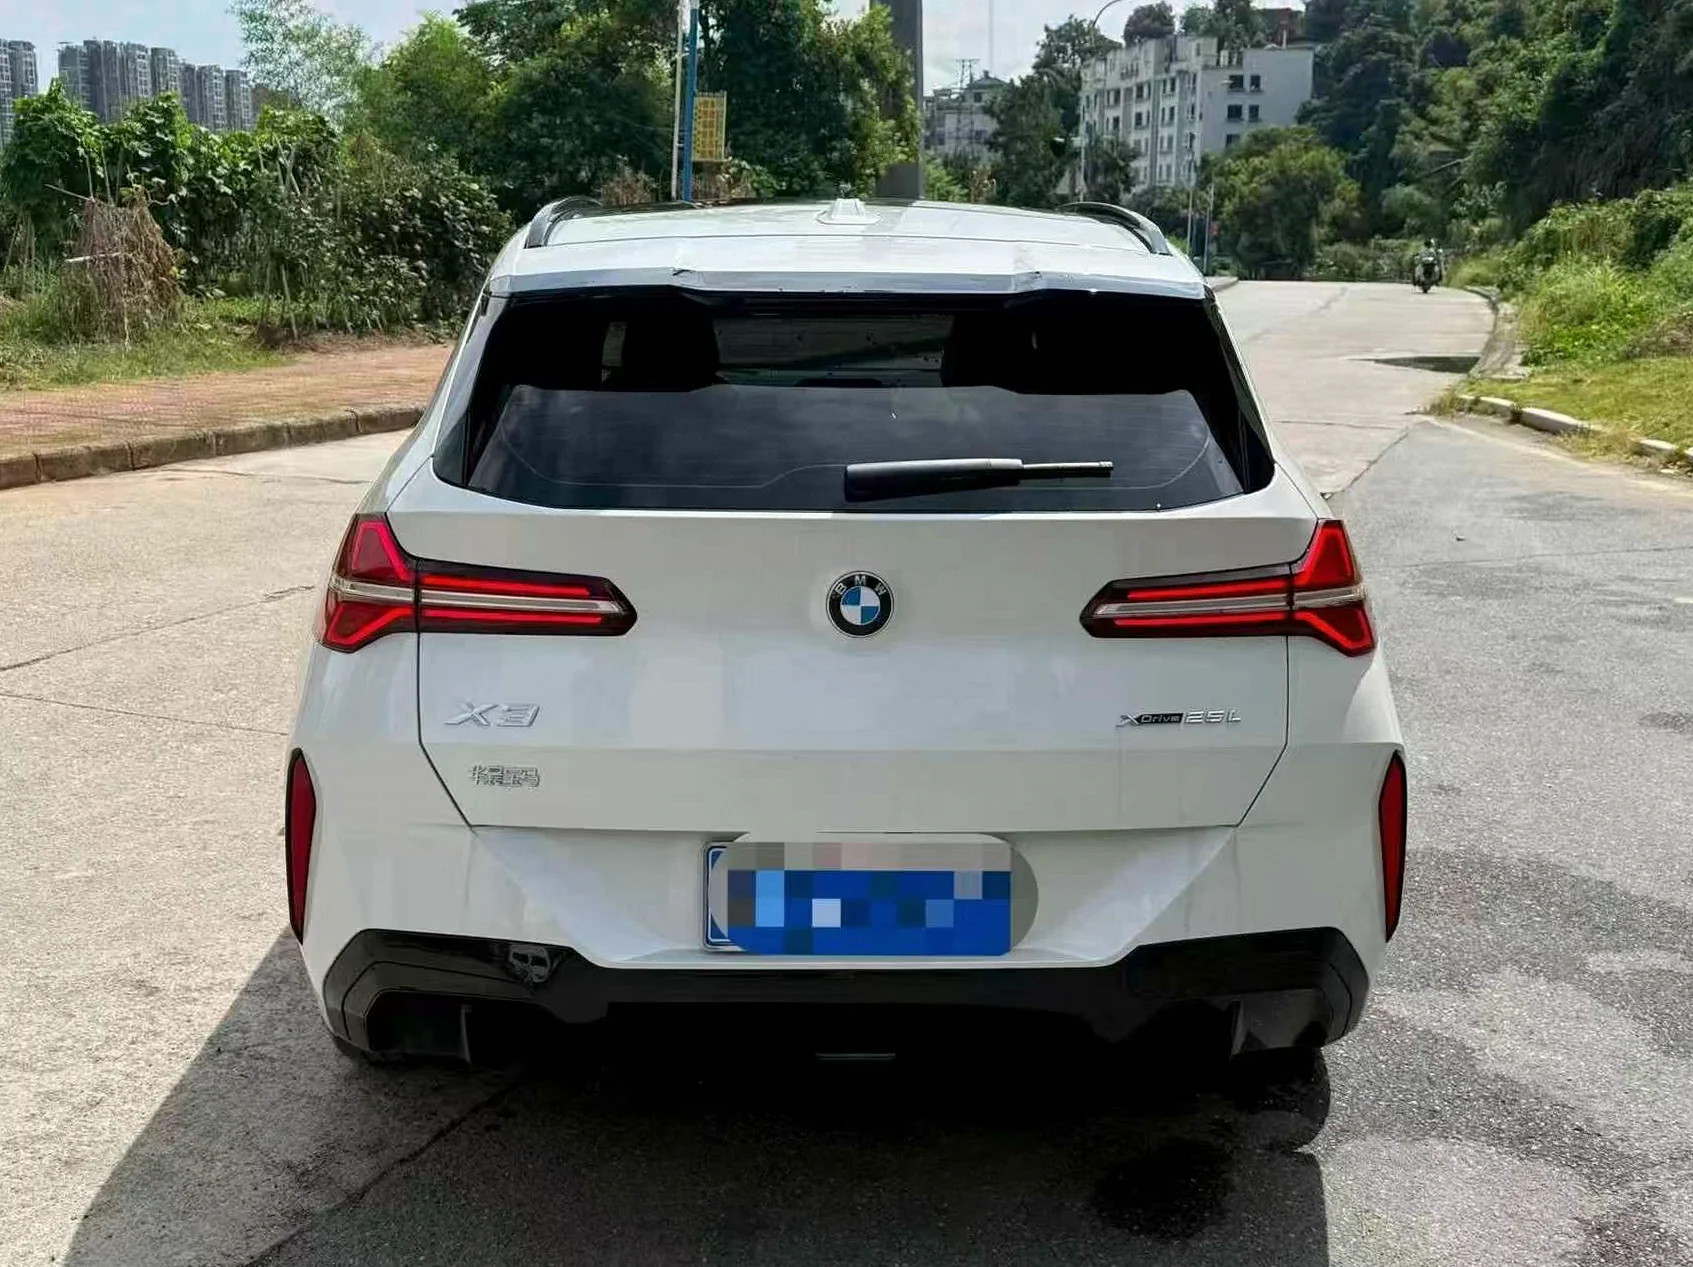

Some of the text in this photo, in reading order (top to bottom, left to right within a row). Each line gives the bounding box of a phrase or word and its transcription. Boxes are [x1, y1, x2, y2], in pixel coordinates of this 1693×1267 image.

[834, 575, 887, 596] BMW
[443, 702, 540, 728] X3
[1184, 710, 1241, 723] 25L
